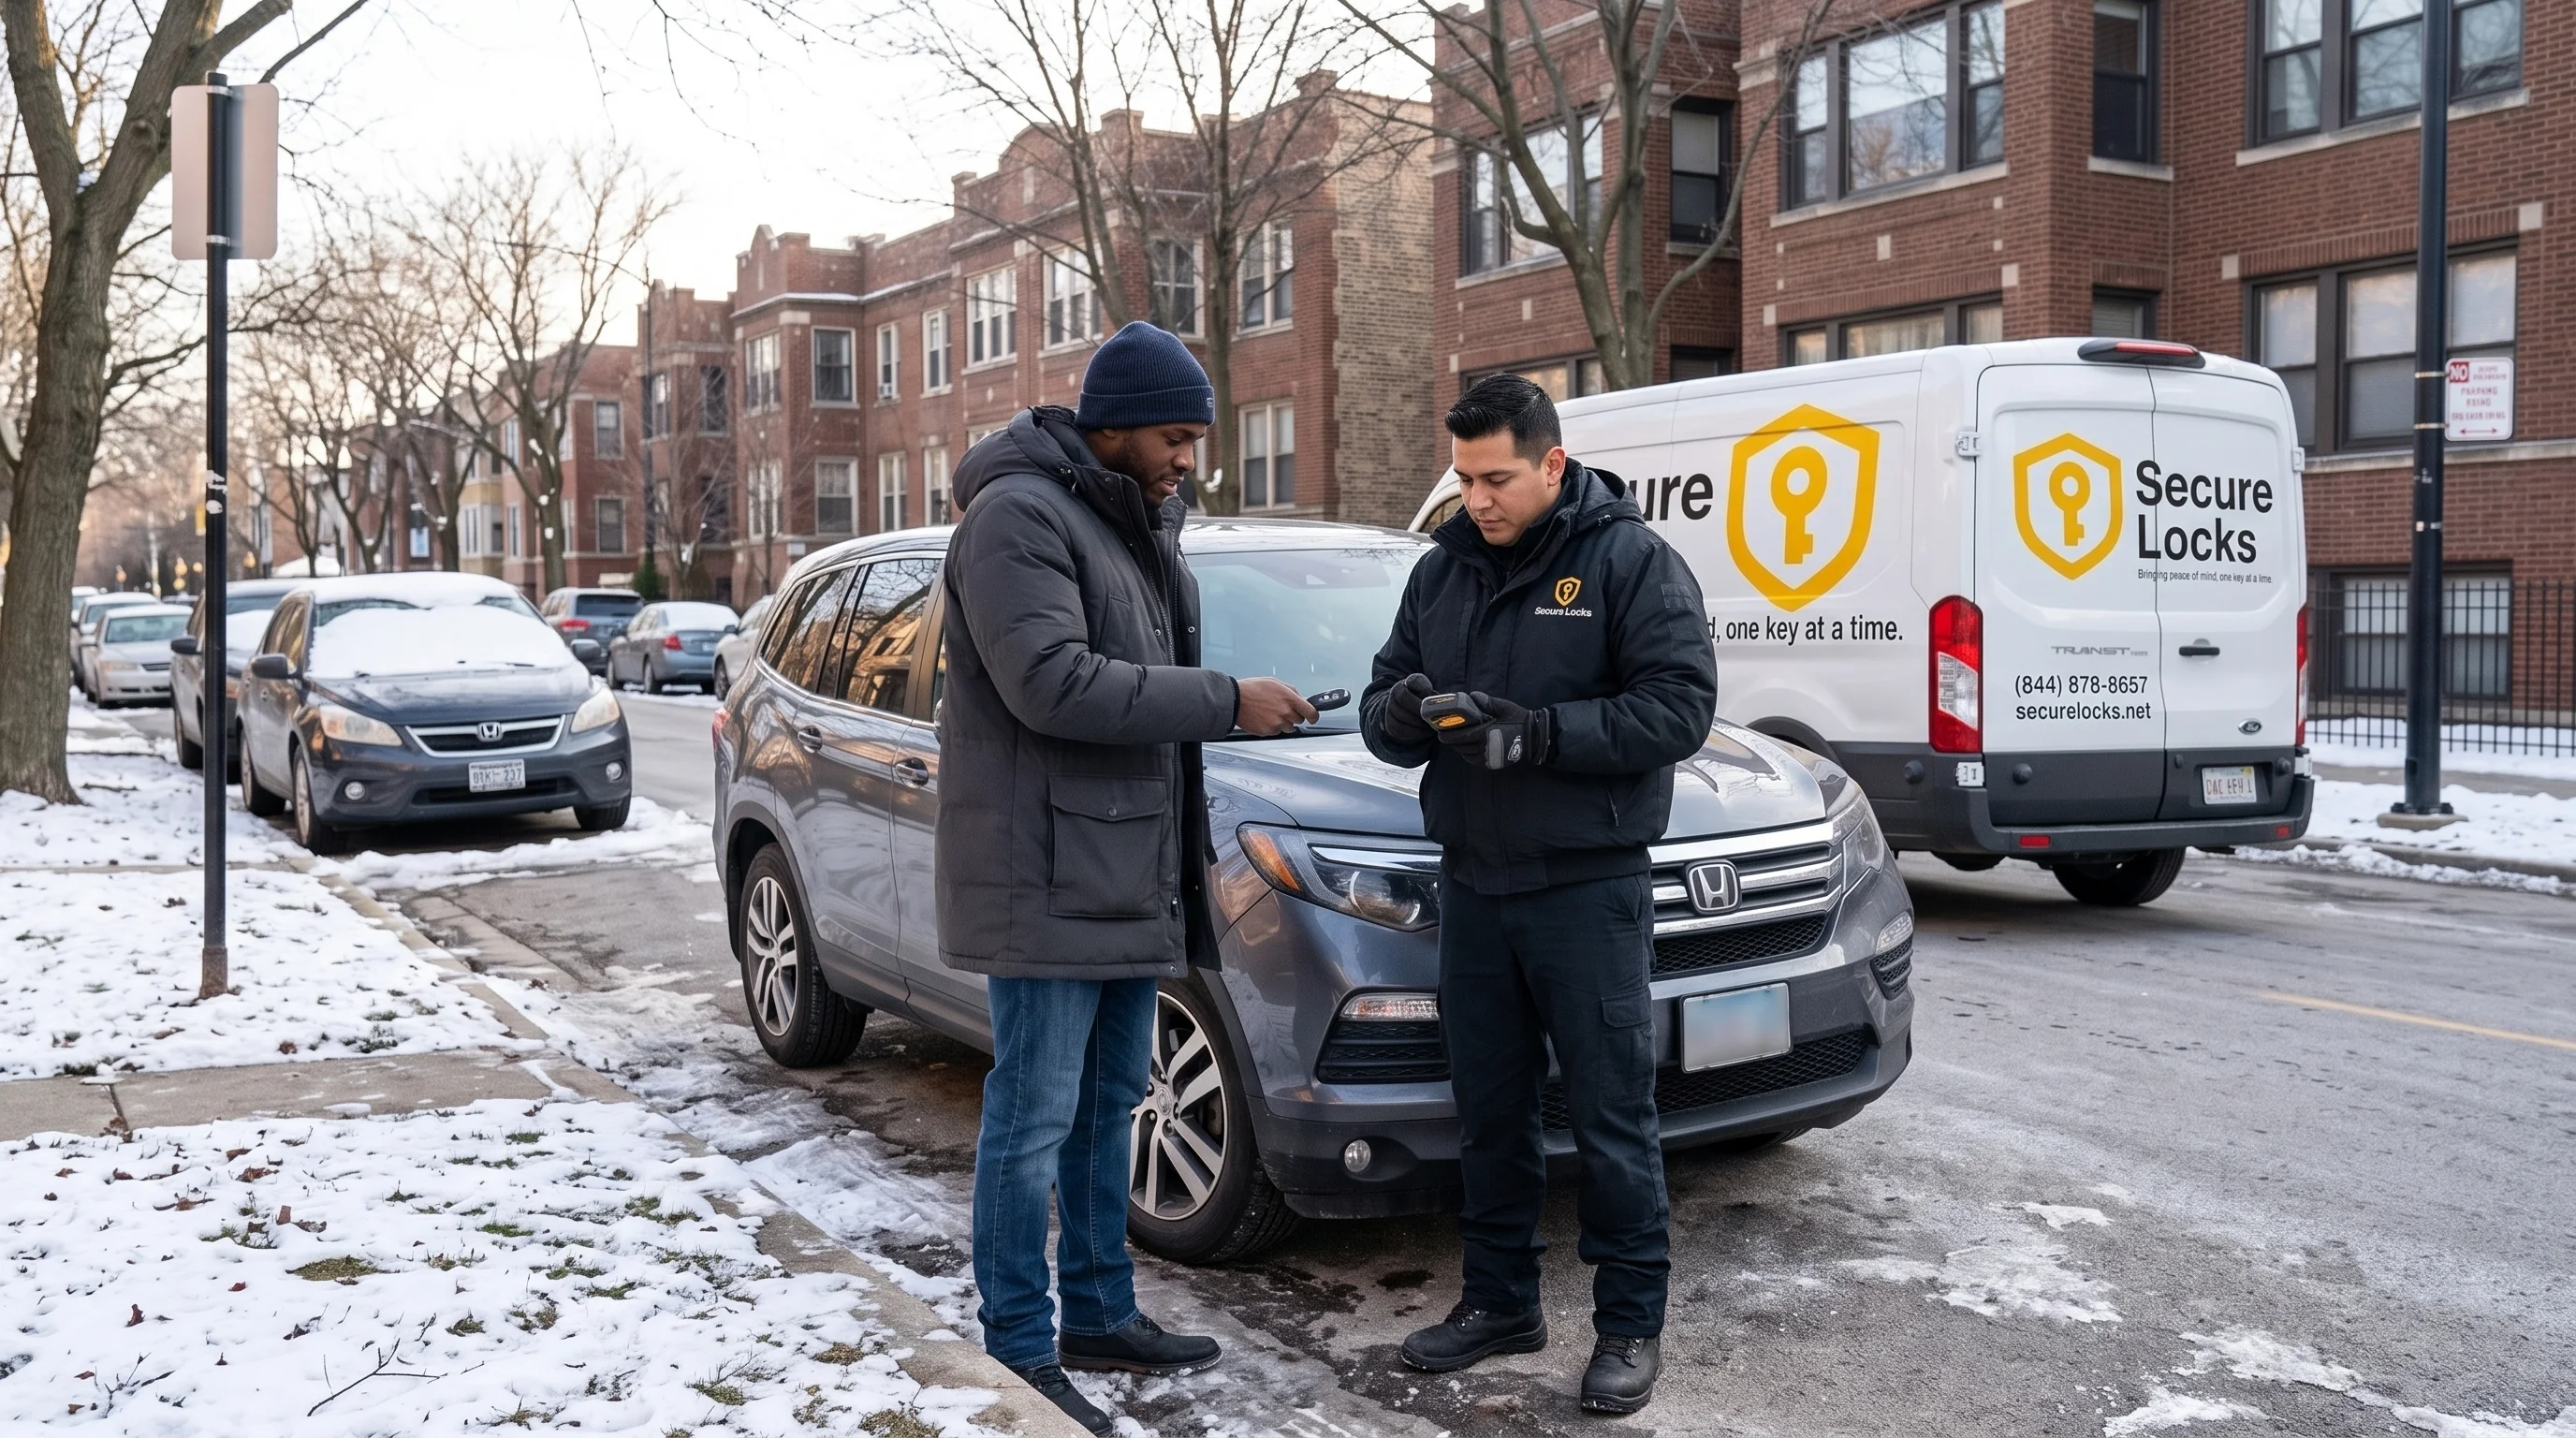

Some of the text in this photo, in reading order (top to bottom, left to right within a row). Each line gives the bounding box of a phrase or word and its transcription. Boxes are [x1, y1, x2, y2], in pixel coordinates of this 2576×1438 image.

[2450, 364, 2468, 381] NO
[1629, 473, 1713, 521] ure
[2136, 460, 2273, 513] Secure
[2138, 514, 2257, 564] Locks
[2138, 569, 2168, 581] Bringing
[2170, 572, 2190, 581] peace
[2191, 571, 2199, 580] of
[2201, 570, 2217, 581] mind,
[2219, 573, 2232, 581] one
[2233, 573, 2244, 584] key
[1565, 608, 1592, 617] Locks
[1726, 621, 1759, 640] one
[1766, 615, 1799, 646] key
[1805, 616, 1824, 640] at
[1831, 621, 1843, 640] a
[1850, 614, 1903, 640] time.
[2015, 675, 2148, 697] (844) 878-8657
[2015, 701, 2152, 720] securelocks.net
